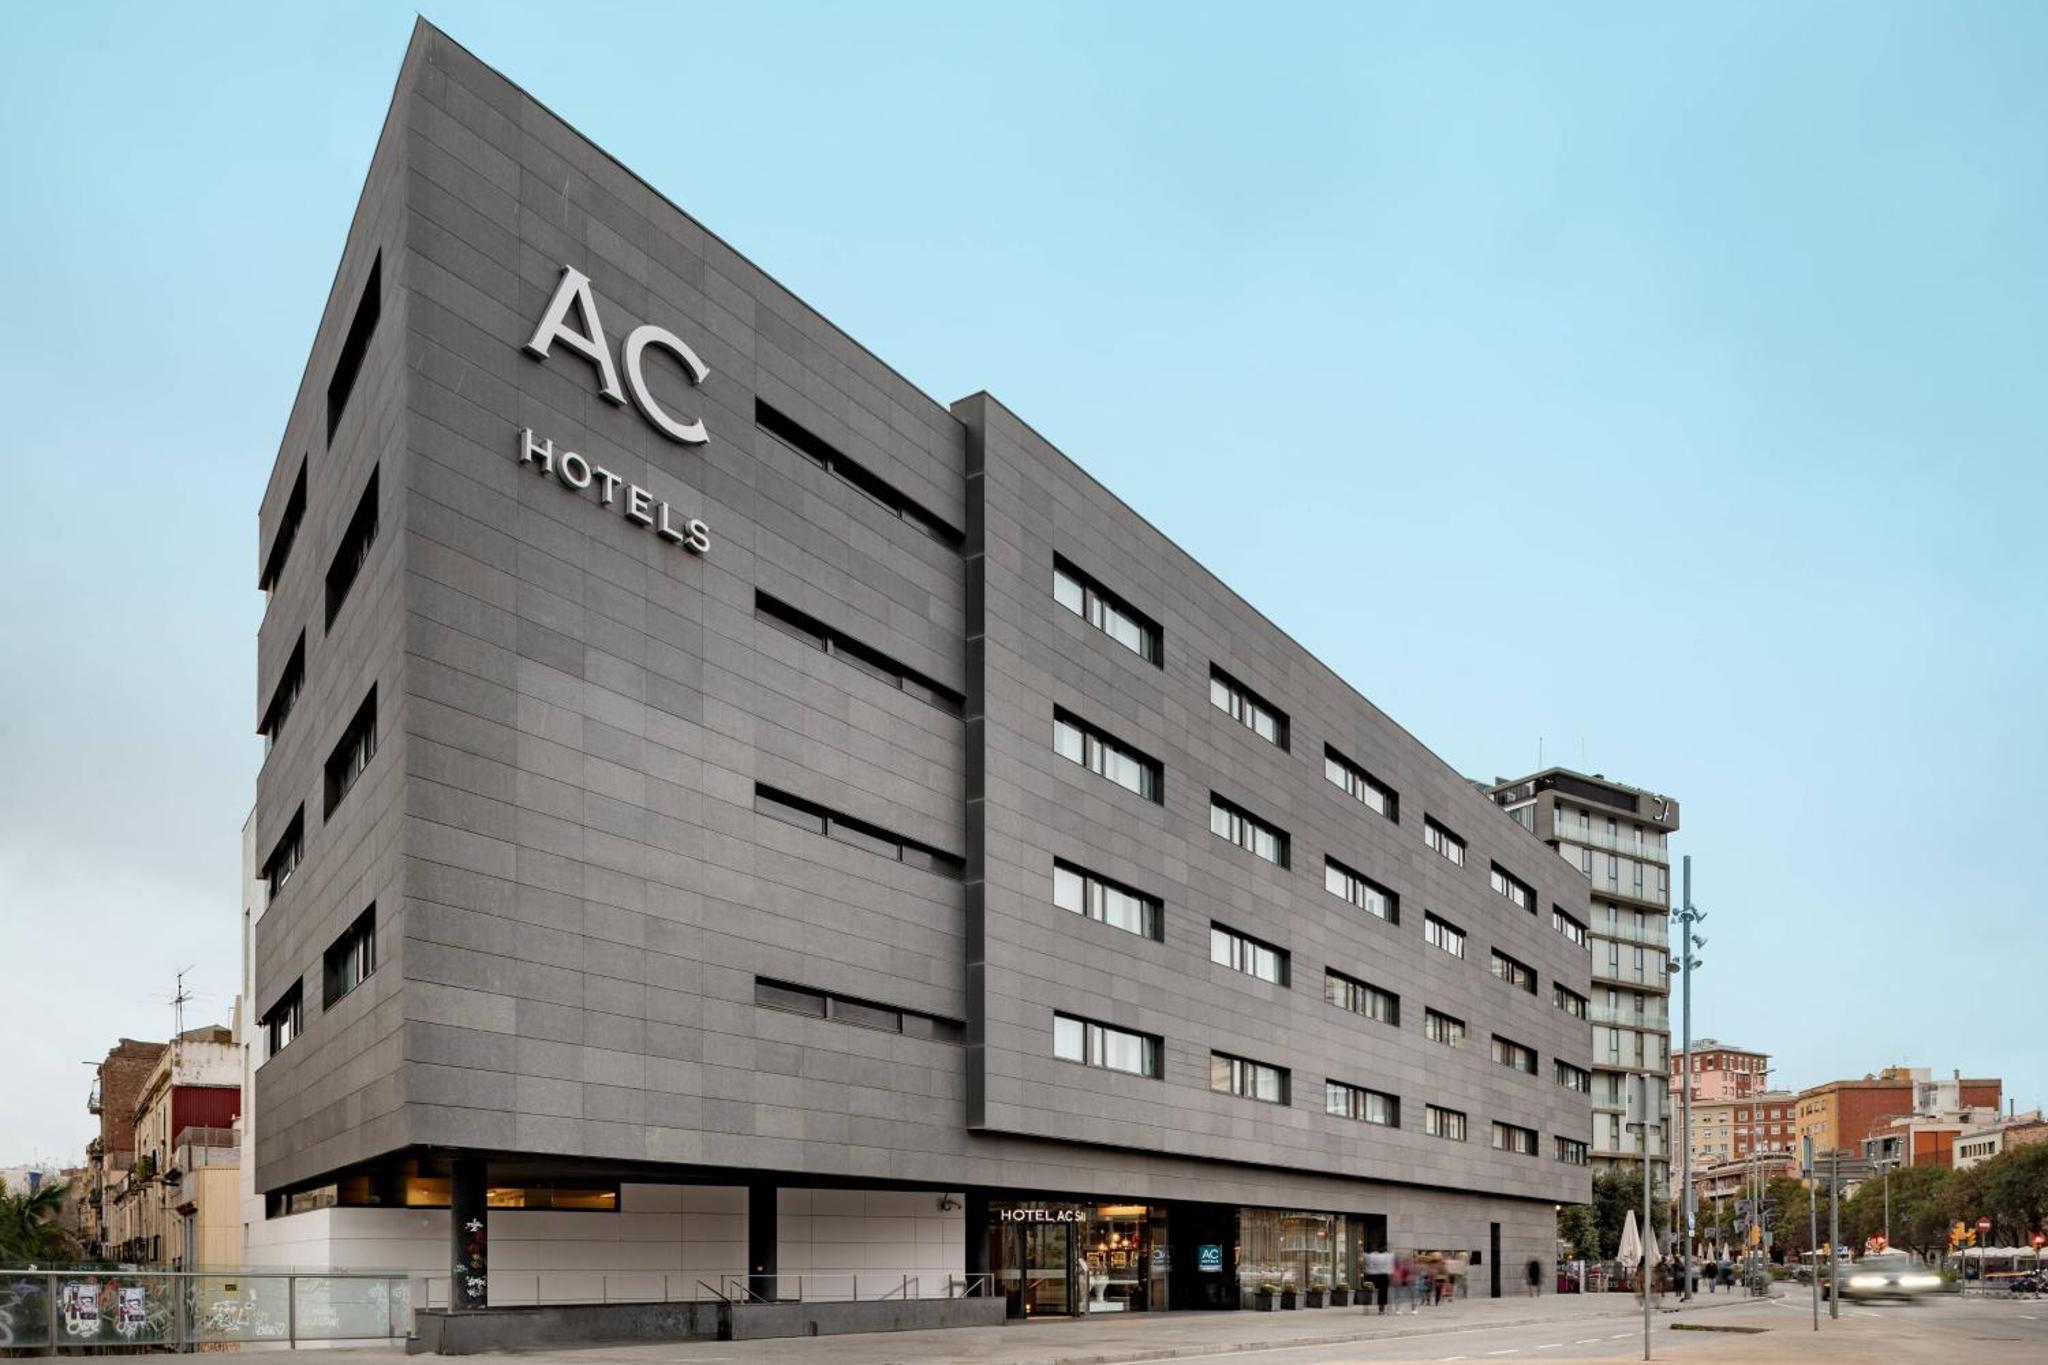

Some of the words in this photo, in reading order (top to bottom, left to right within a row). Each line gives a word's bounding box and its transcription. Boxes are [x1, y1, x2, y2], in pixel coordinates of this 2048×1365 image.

[522, 264, 711, 445] AC
[520, 427, 711, 552] HOTELS
[1001, 1209, 1055, 1222] HOTEL
[1057, 1210, 1073, 1222] AC
[1202, 1249, 1219, 1260] AC
